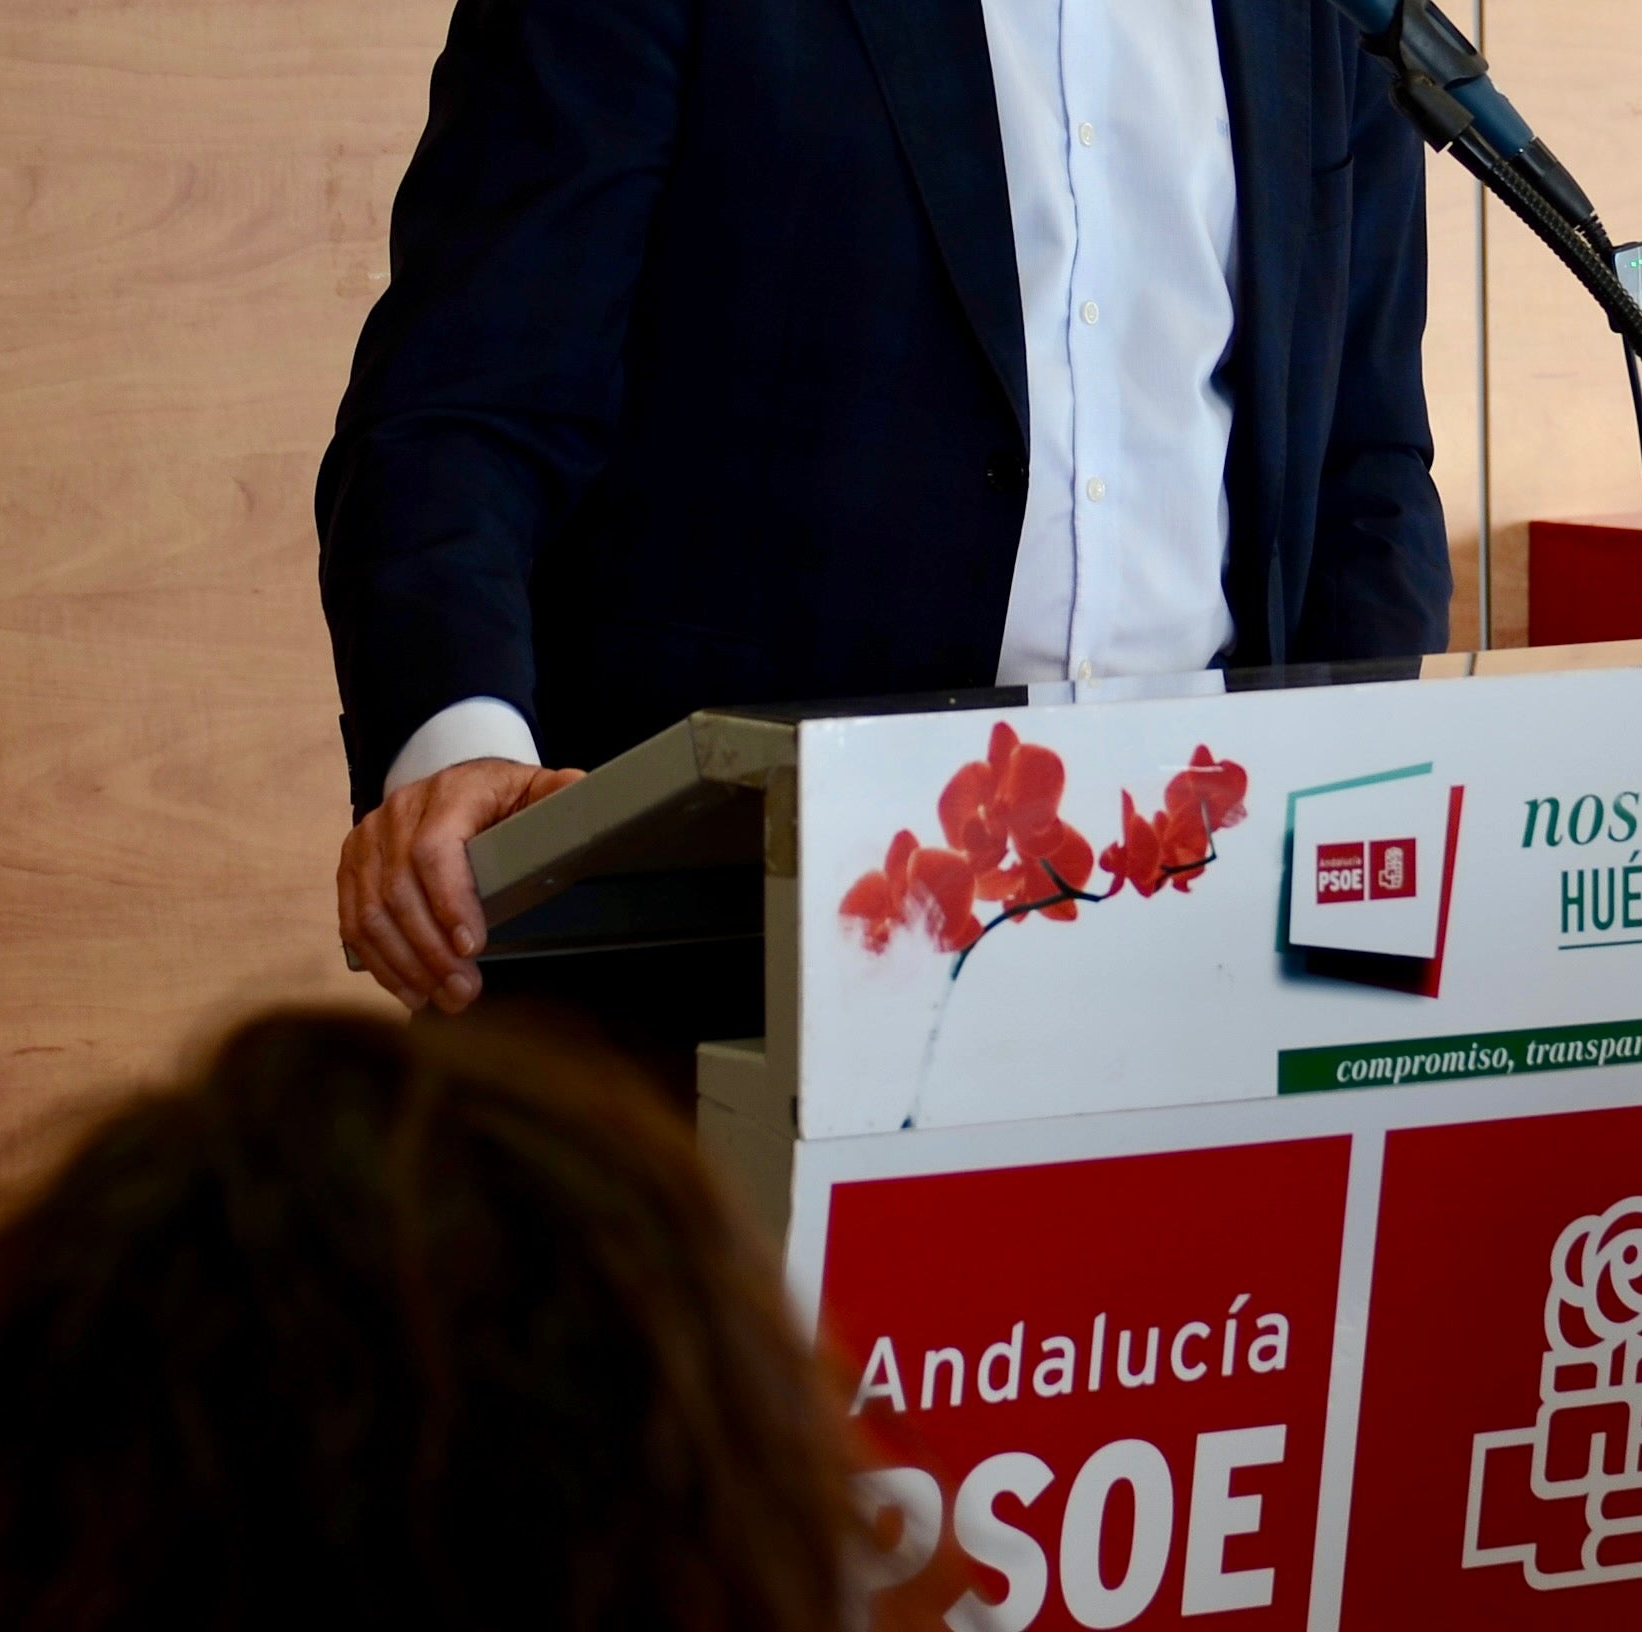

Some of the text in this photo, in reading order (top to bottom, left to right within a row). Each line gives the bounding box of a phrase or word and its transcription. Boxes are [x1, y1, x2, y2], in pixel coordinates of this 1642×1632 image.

[1521, 791, 1640, 848] nos
[1318, 868, 1363, 892] PSOE
[1336, 1043, 1515, 1083] compromiso,
[848, 1293, 1290, 1416] Andalucía
